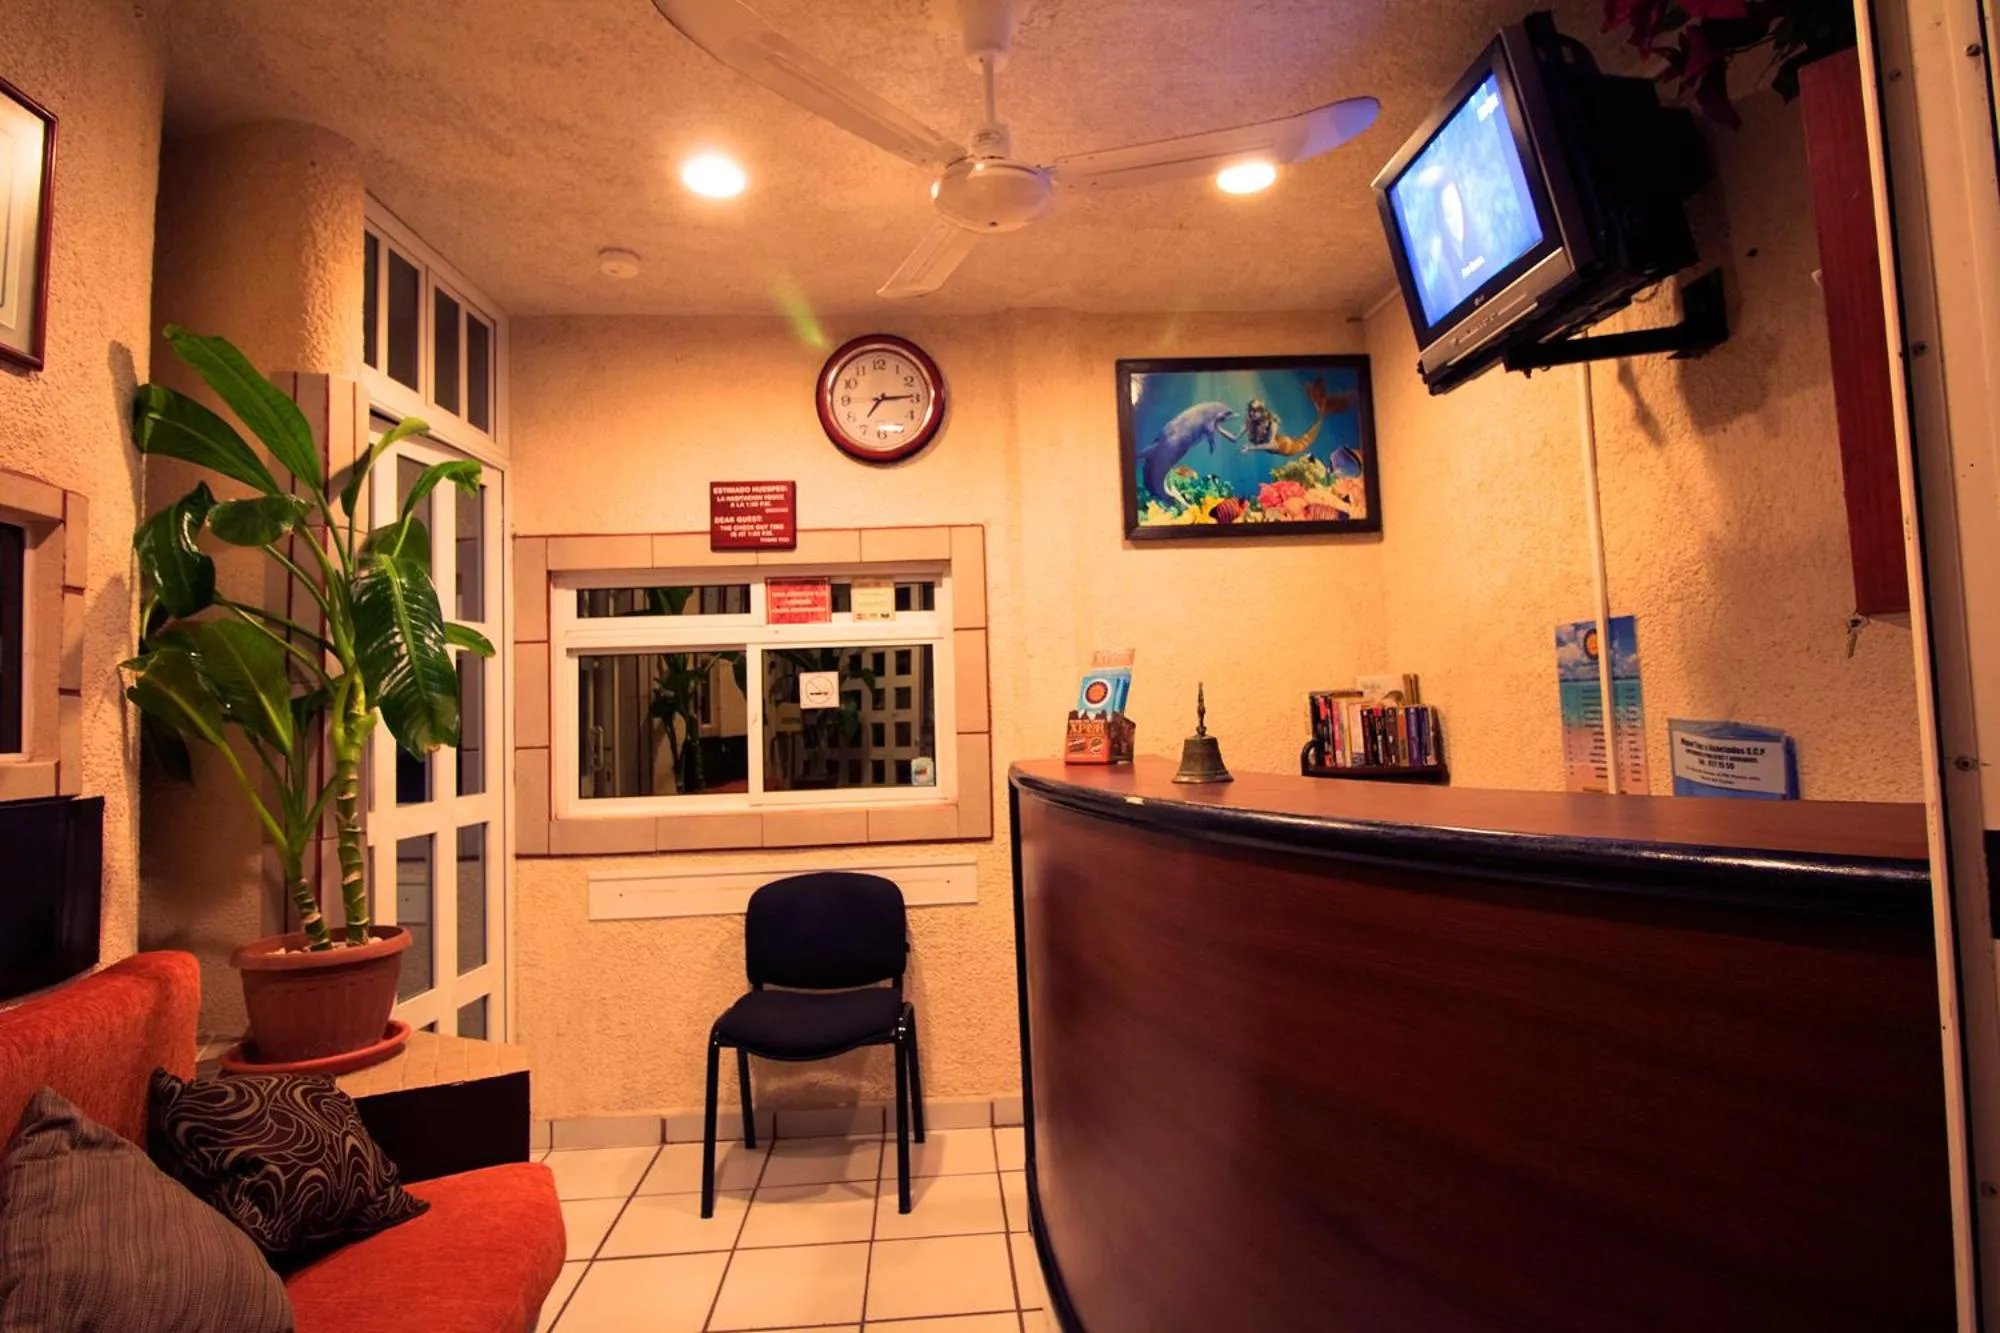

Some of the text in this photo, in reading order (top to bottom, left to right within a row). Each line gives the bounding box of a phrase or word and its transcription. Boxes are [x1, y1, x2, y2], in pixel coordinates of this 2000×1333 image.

[873, 359, 886, 370] 12
[895, 364, 900, 375] 1
[857, 366, 866, 376] 11
[845, 379, 857, 389] 10
[904, 376, 914, 387] 2
[841, 395, 850, 406] 9
[905, 410, 914, 420] 4
[860, 425, 867, 436] 7
[713, 486, 751, 494] ESTIMADO
